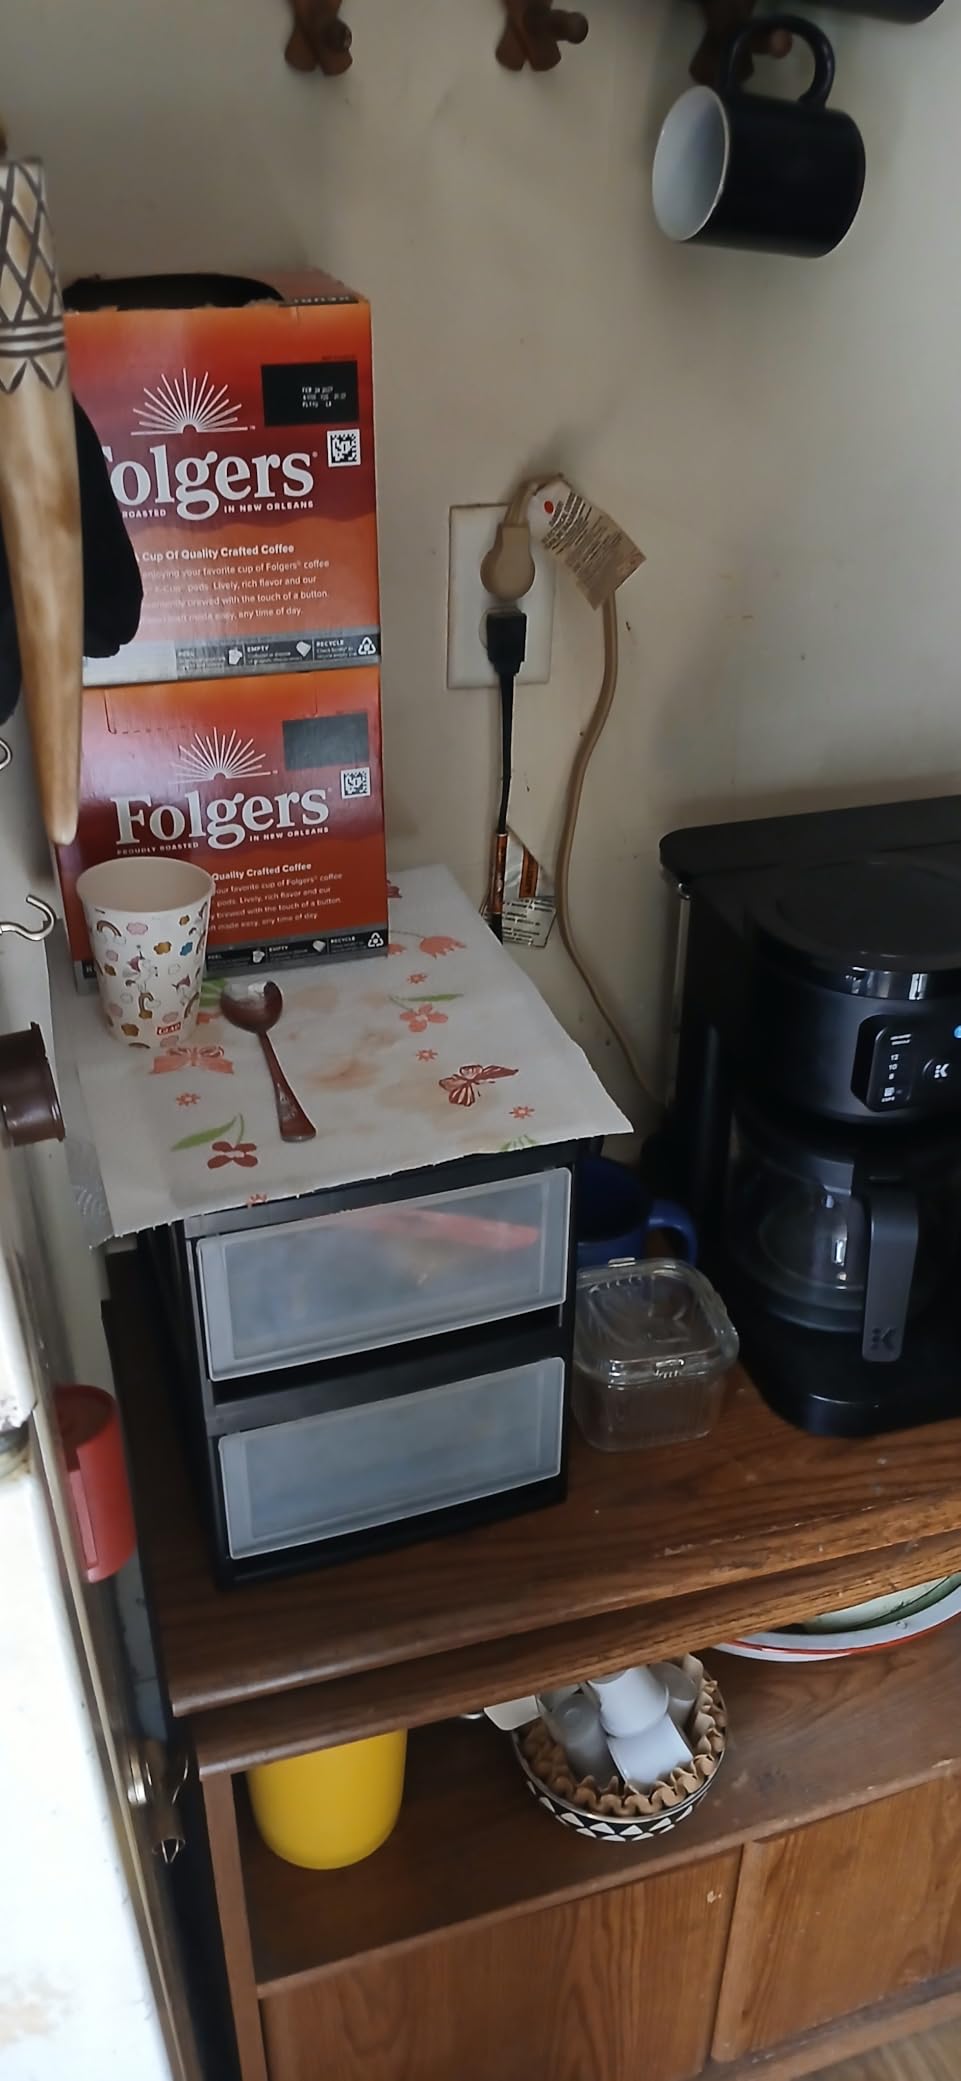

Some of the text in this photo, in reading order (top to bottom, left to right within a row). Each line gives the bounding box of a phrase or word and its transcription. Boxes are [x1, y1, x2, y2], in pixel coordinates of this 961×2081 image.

[122, 500, 314, 519] ROASTED IN NEW ORLEANS
[142, 552, 164, 564] Cup
[165, 550, 180, 561] Of
[181, 547, 219, 561] Quality
[220, 545, 259, 558] Crafted
[260, 543, 295, 555] Coffee
[203, 565, 235, 577] favorite
[237, 564, 254, 574] cup
[255, 562, 264, 572] of
[303, 559, 330, 569] coffee
[212, 581, 240, 592] Lively,
[241, 578, 258, 589] rich
[259, 577, 283, 588] flavor
[284, 575, 301, 585] and
[302, 576, 317, 584] our
[222, 595, 240, 605] with
[241, 594, 256, 603] the
[257, 592, 281, 602] touch
[282, 591, 292, 600] of
[238, 610, 254, 619] any
[255, 608, 274, 617] time
[275, 607, 285, 615] of
[316, 639, 345, 648] RECYCLE
[110, 787, 330, 850] Folgers
[159, 841, 199, 851] ROASTED
[249, 834, 260, 842] IN
[263, 831, 284, 841] NEW
[287, 826, 330, 838] ORLEANS
[211, 862, 312, 881] Quality Crafted Coffee
[230, 883, 260, 893] favorite
[261, 882, 276, 891] cup
[276, 879, 286, 888] of
[319, 872, 343, 882] coffee
[264, 892, 279, 902] rich
[301, 900, 310, 908] of
